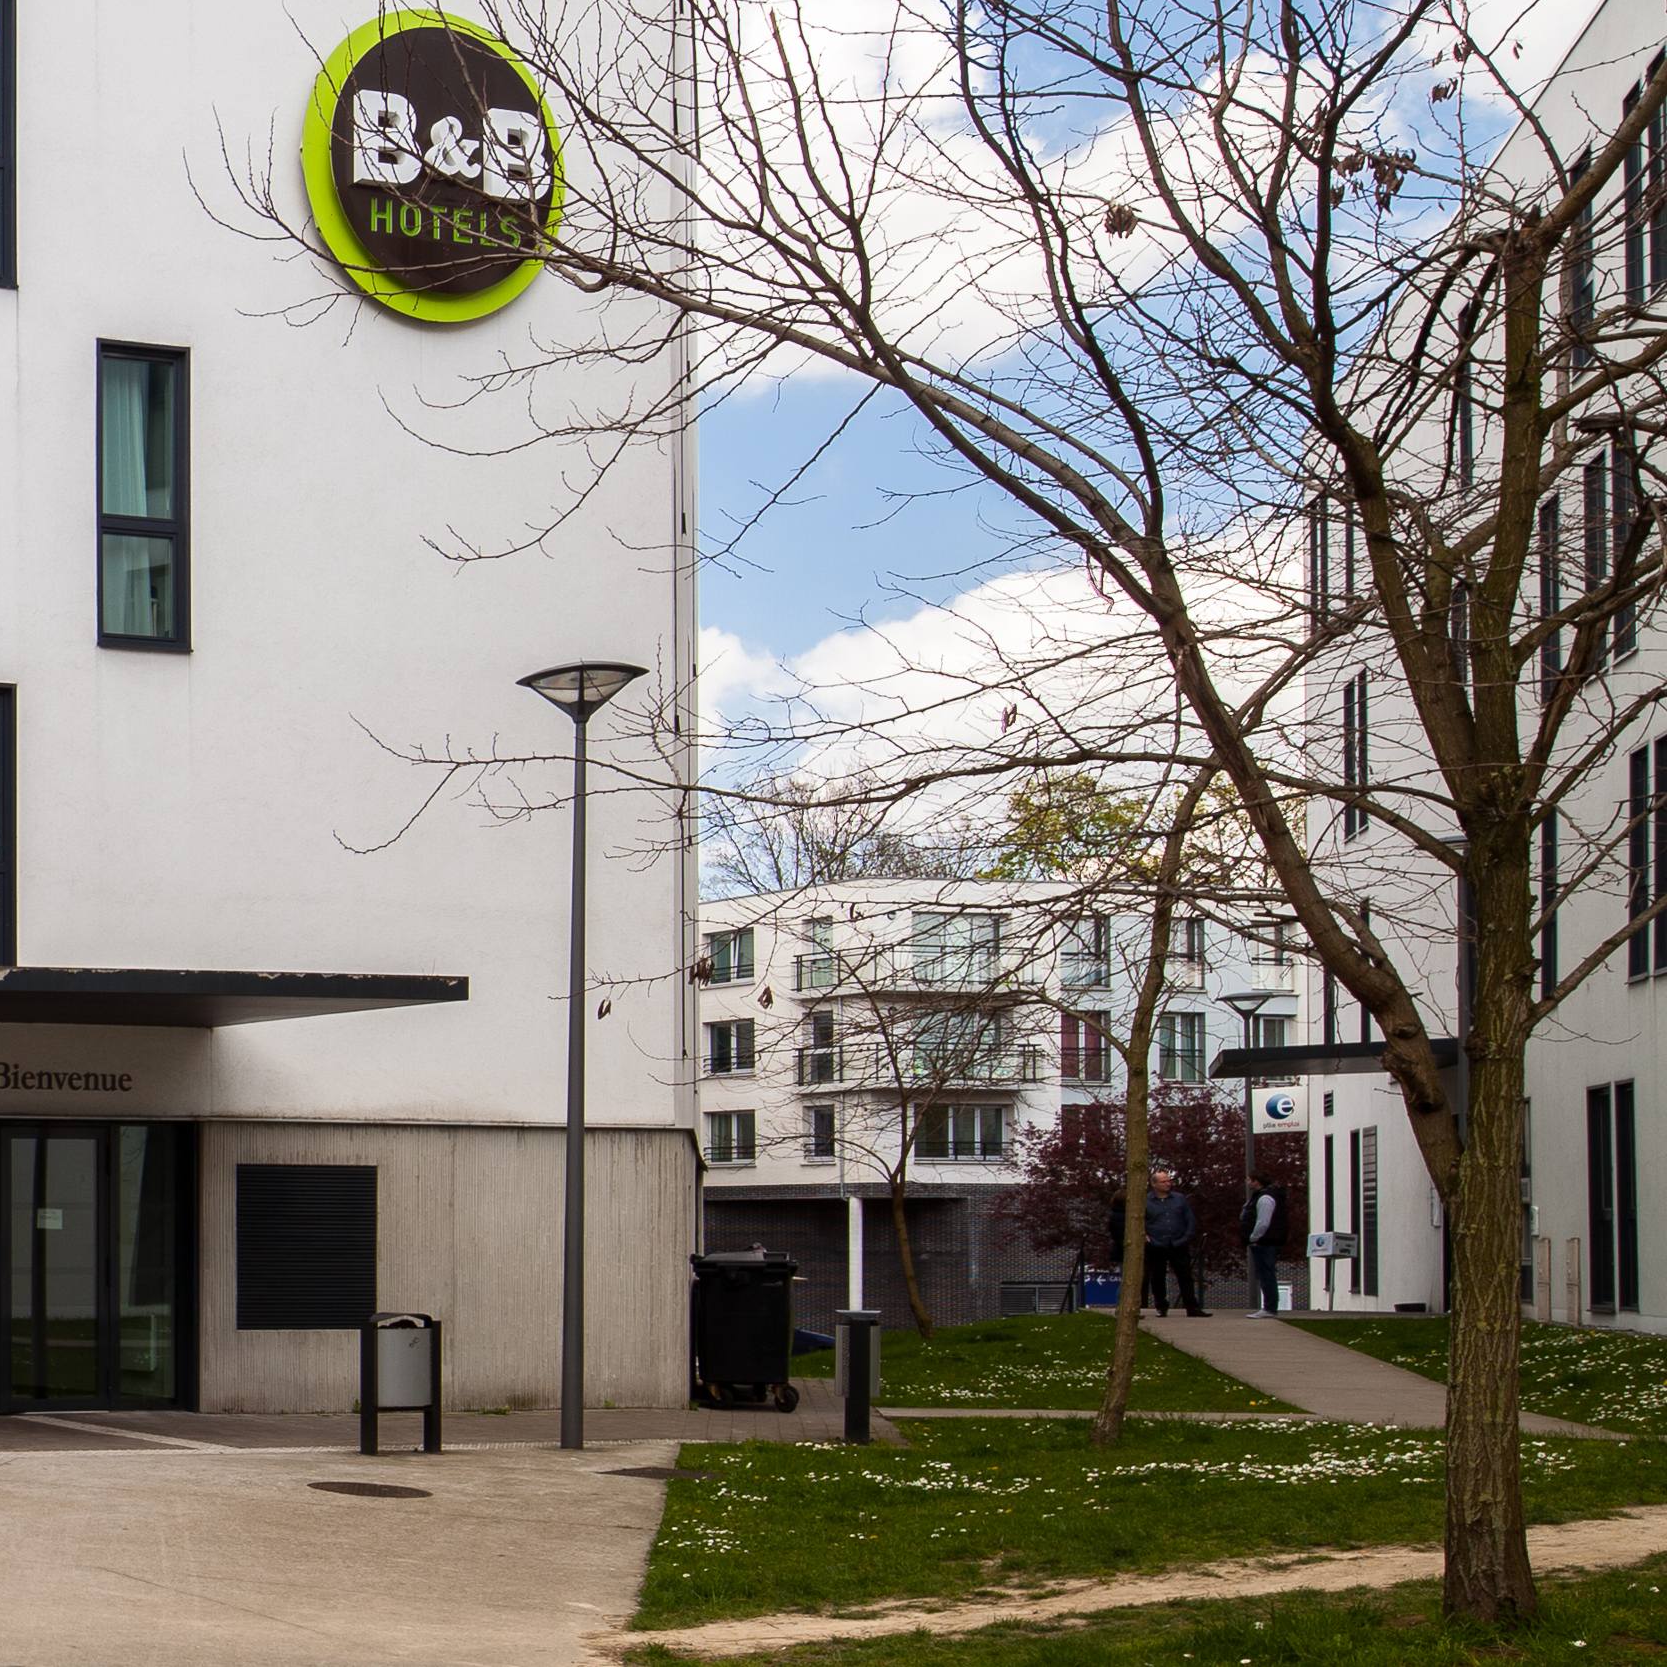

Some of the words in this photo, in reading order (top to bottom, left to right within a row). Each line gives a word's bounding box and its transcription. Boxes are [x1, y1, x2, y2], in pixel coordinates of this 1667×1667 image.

[352, 89, 554, 204] B&B
[370, 197, 520, 248] HOTELS
[1277, 1120, 1300, 1129] emploi
